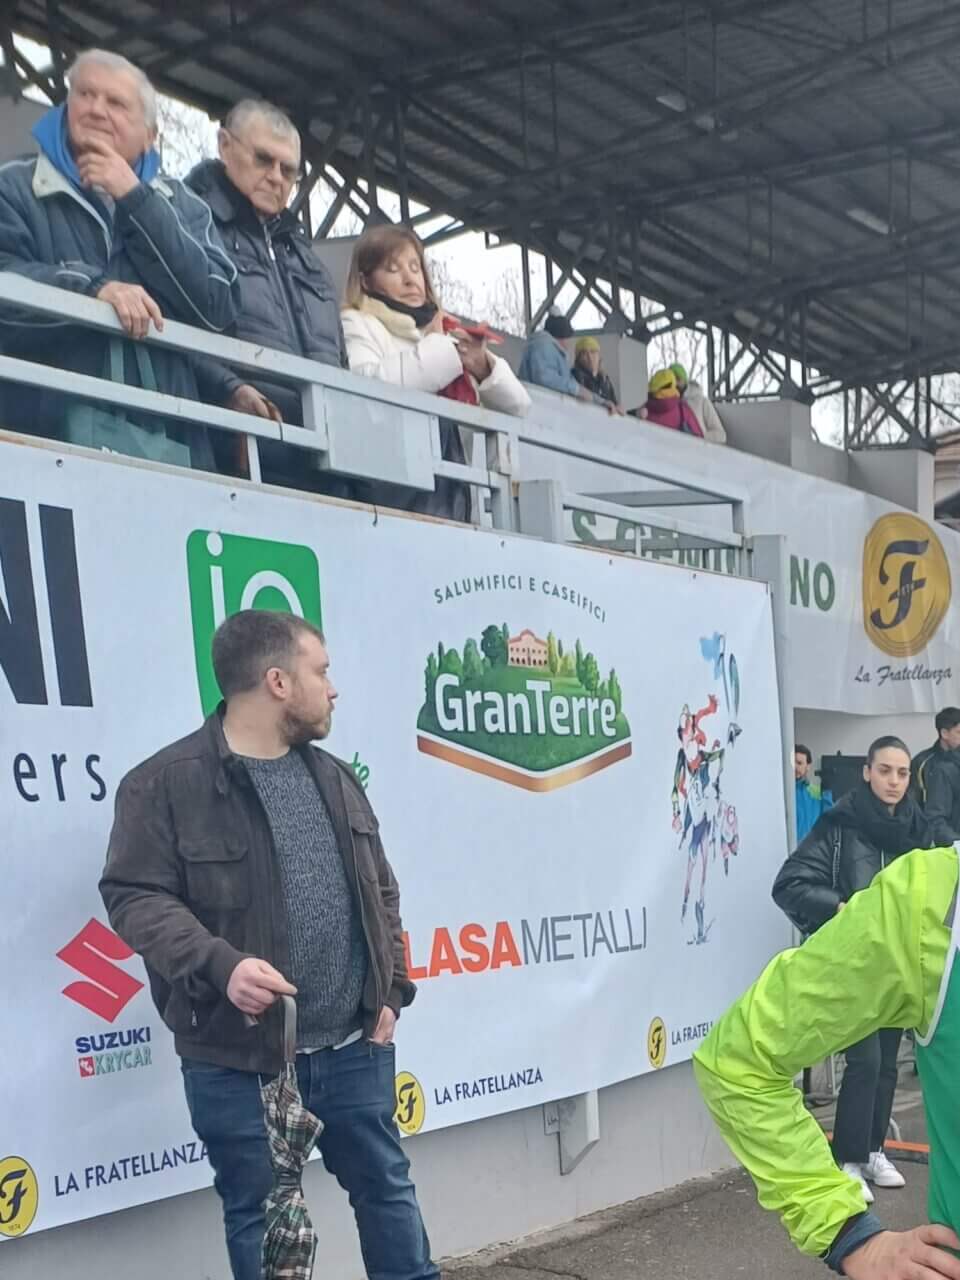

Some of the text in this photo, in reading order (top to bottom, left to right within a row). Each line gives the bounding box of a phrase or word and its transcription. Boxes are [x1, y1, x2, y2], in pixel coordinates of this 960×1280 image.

[434, 574, 606, 623] SALUMIFICI E CASEIFICI
[854, 664, 952, 686] La Fratellanza
[434, 672, 617, 738] GranTerre
[75, 1026, 151, 1054] SUZUKI
[671, 1031, 682, 1046] LA
[95, 1046, 153, 1076] KRYCAR
[434, 1066, 543, 1105] LA FRATELLANZA
[54, 1172, 79, 1197] LA
